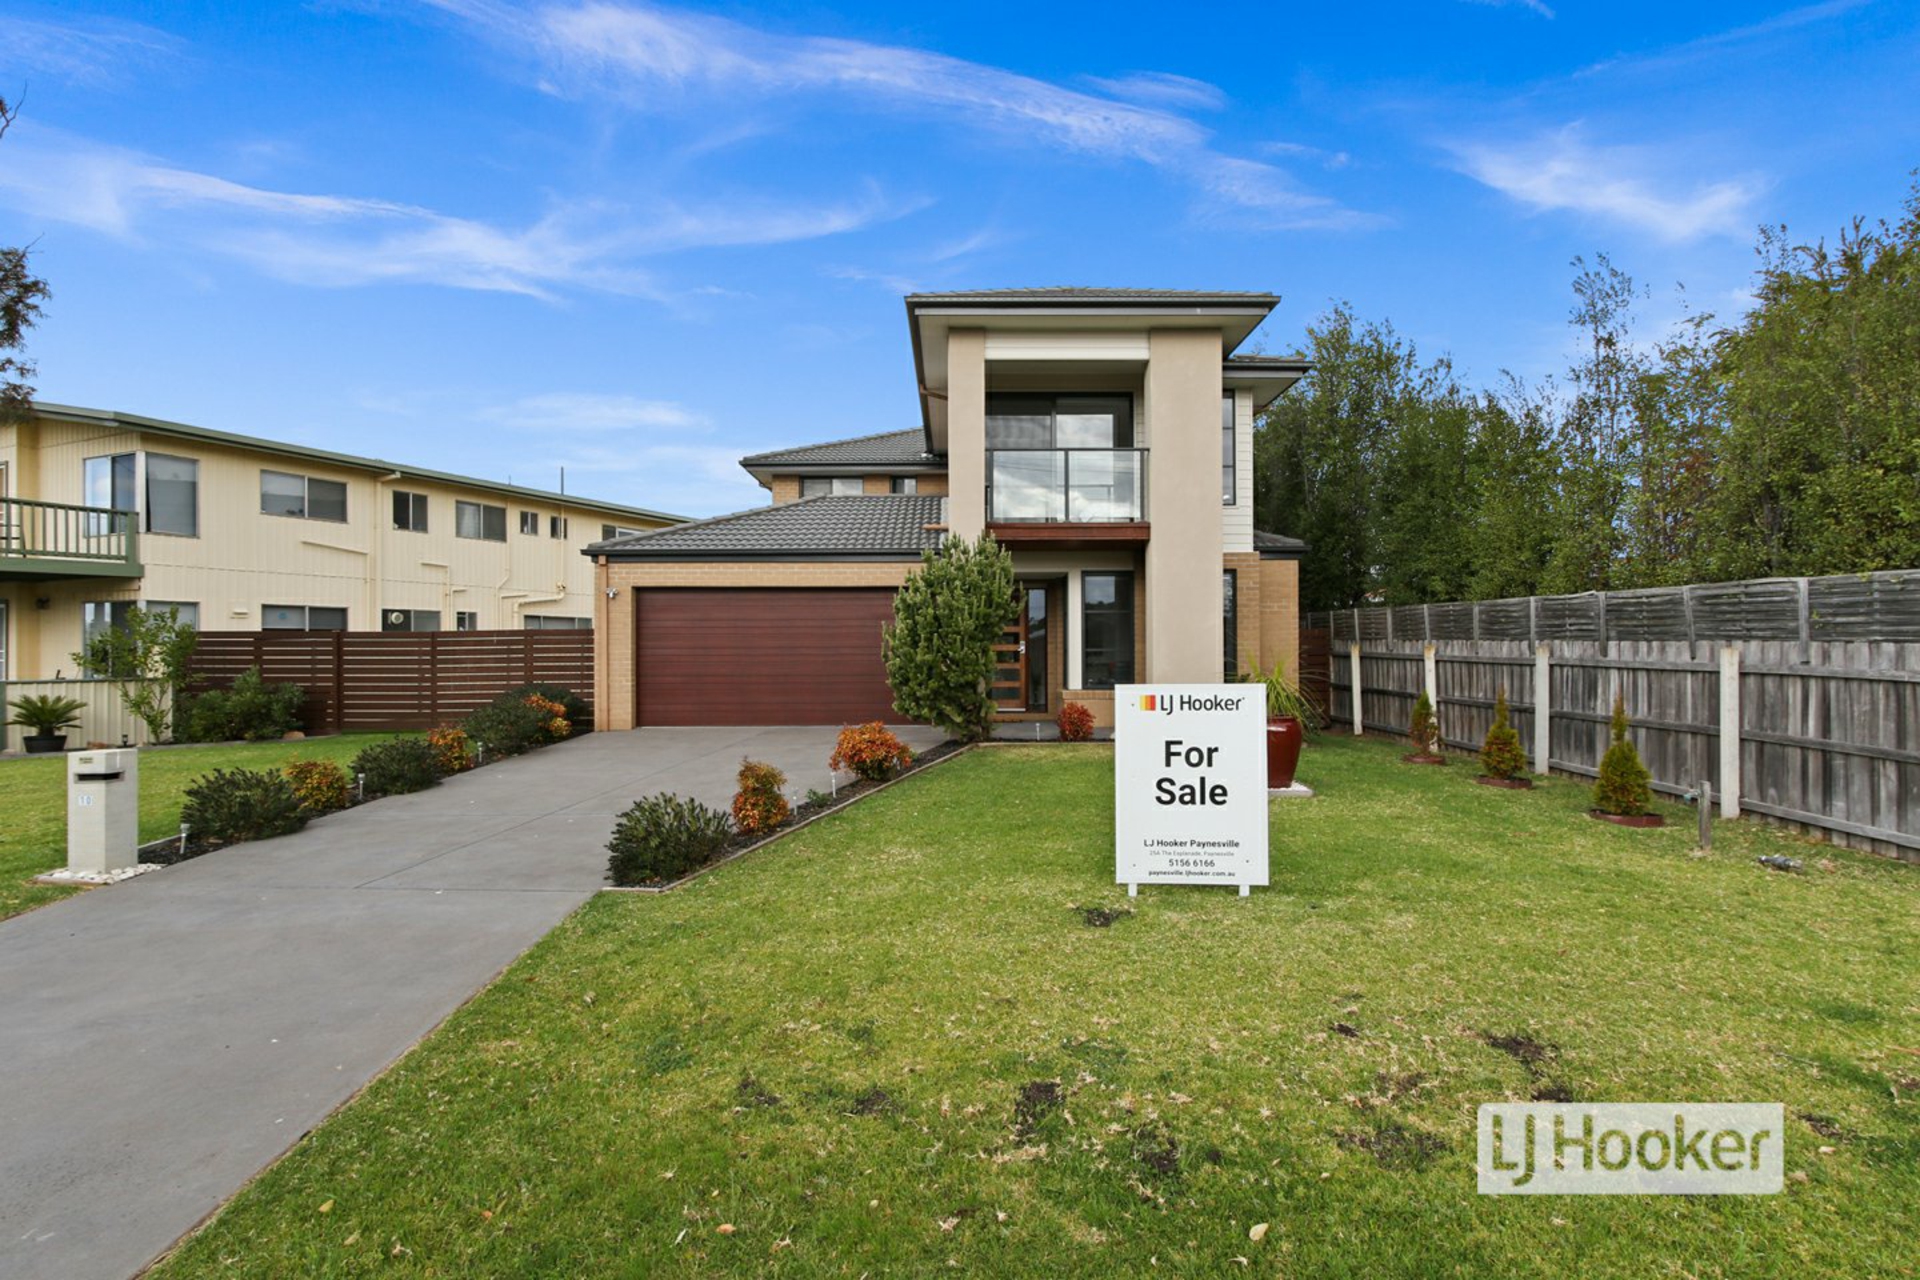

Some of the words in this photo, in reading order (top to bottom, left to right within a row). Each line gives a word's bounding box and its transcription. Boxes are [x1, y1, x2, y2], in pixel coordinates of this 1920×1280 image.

[1160, 695, 1174, 715] LJ
[1180, 695, 1242, 712] Hooker
[1164, 740, 1219, 768] For
[1155, 776, 1228, 806] Sale
[1143, 839, 1154, 848] LJ
[1156, 839, 1188, 848] Hooker
[1190, 839, 1240, 850] Paynesville
[1168, 859, 1191, 868] 5156
[1192, 859, 1216, 868] 6166
[1148, 870, 1236, 878] paynesville.ljhooker.com.au
